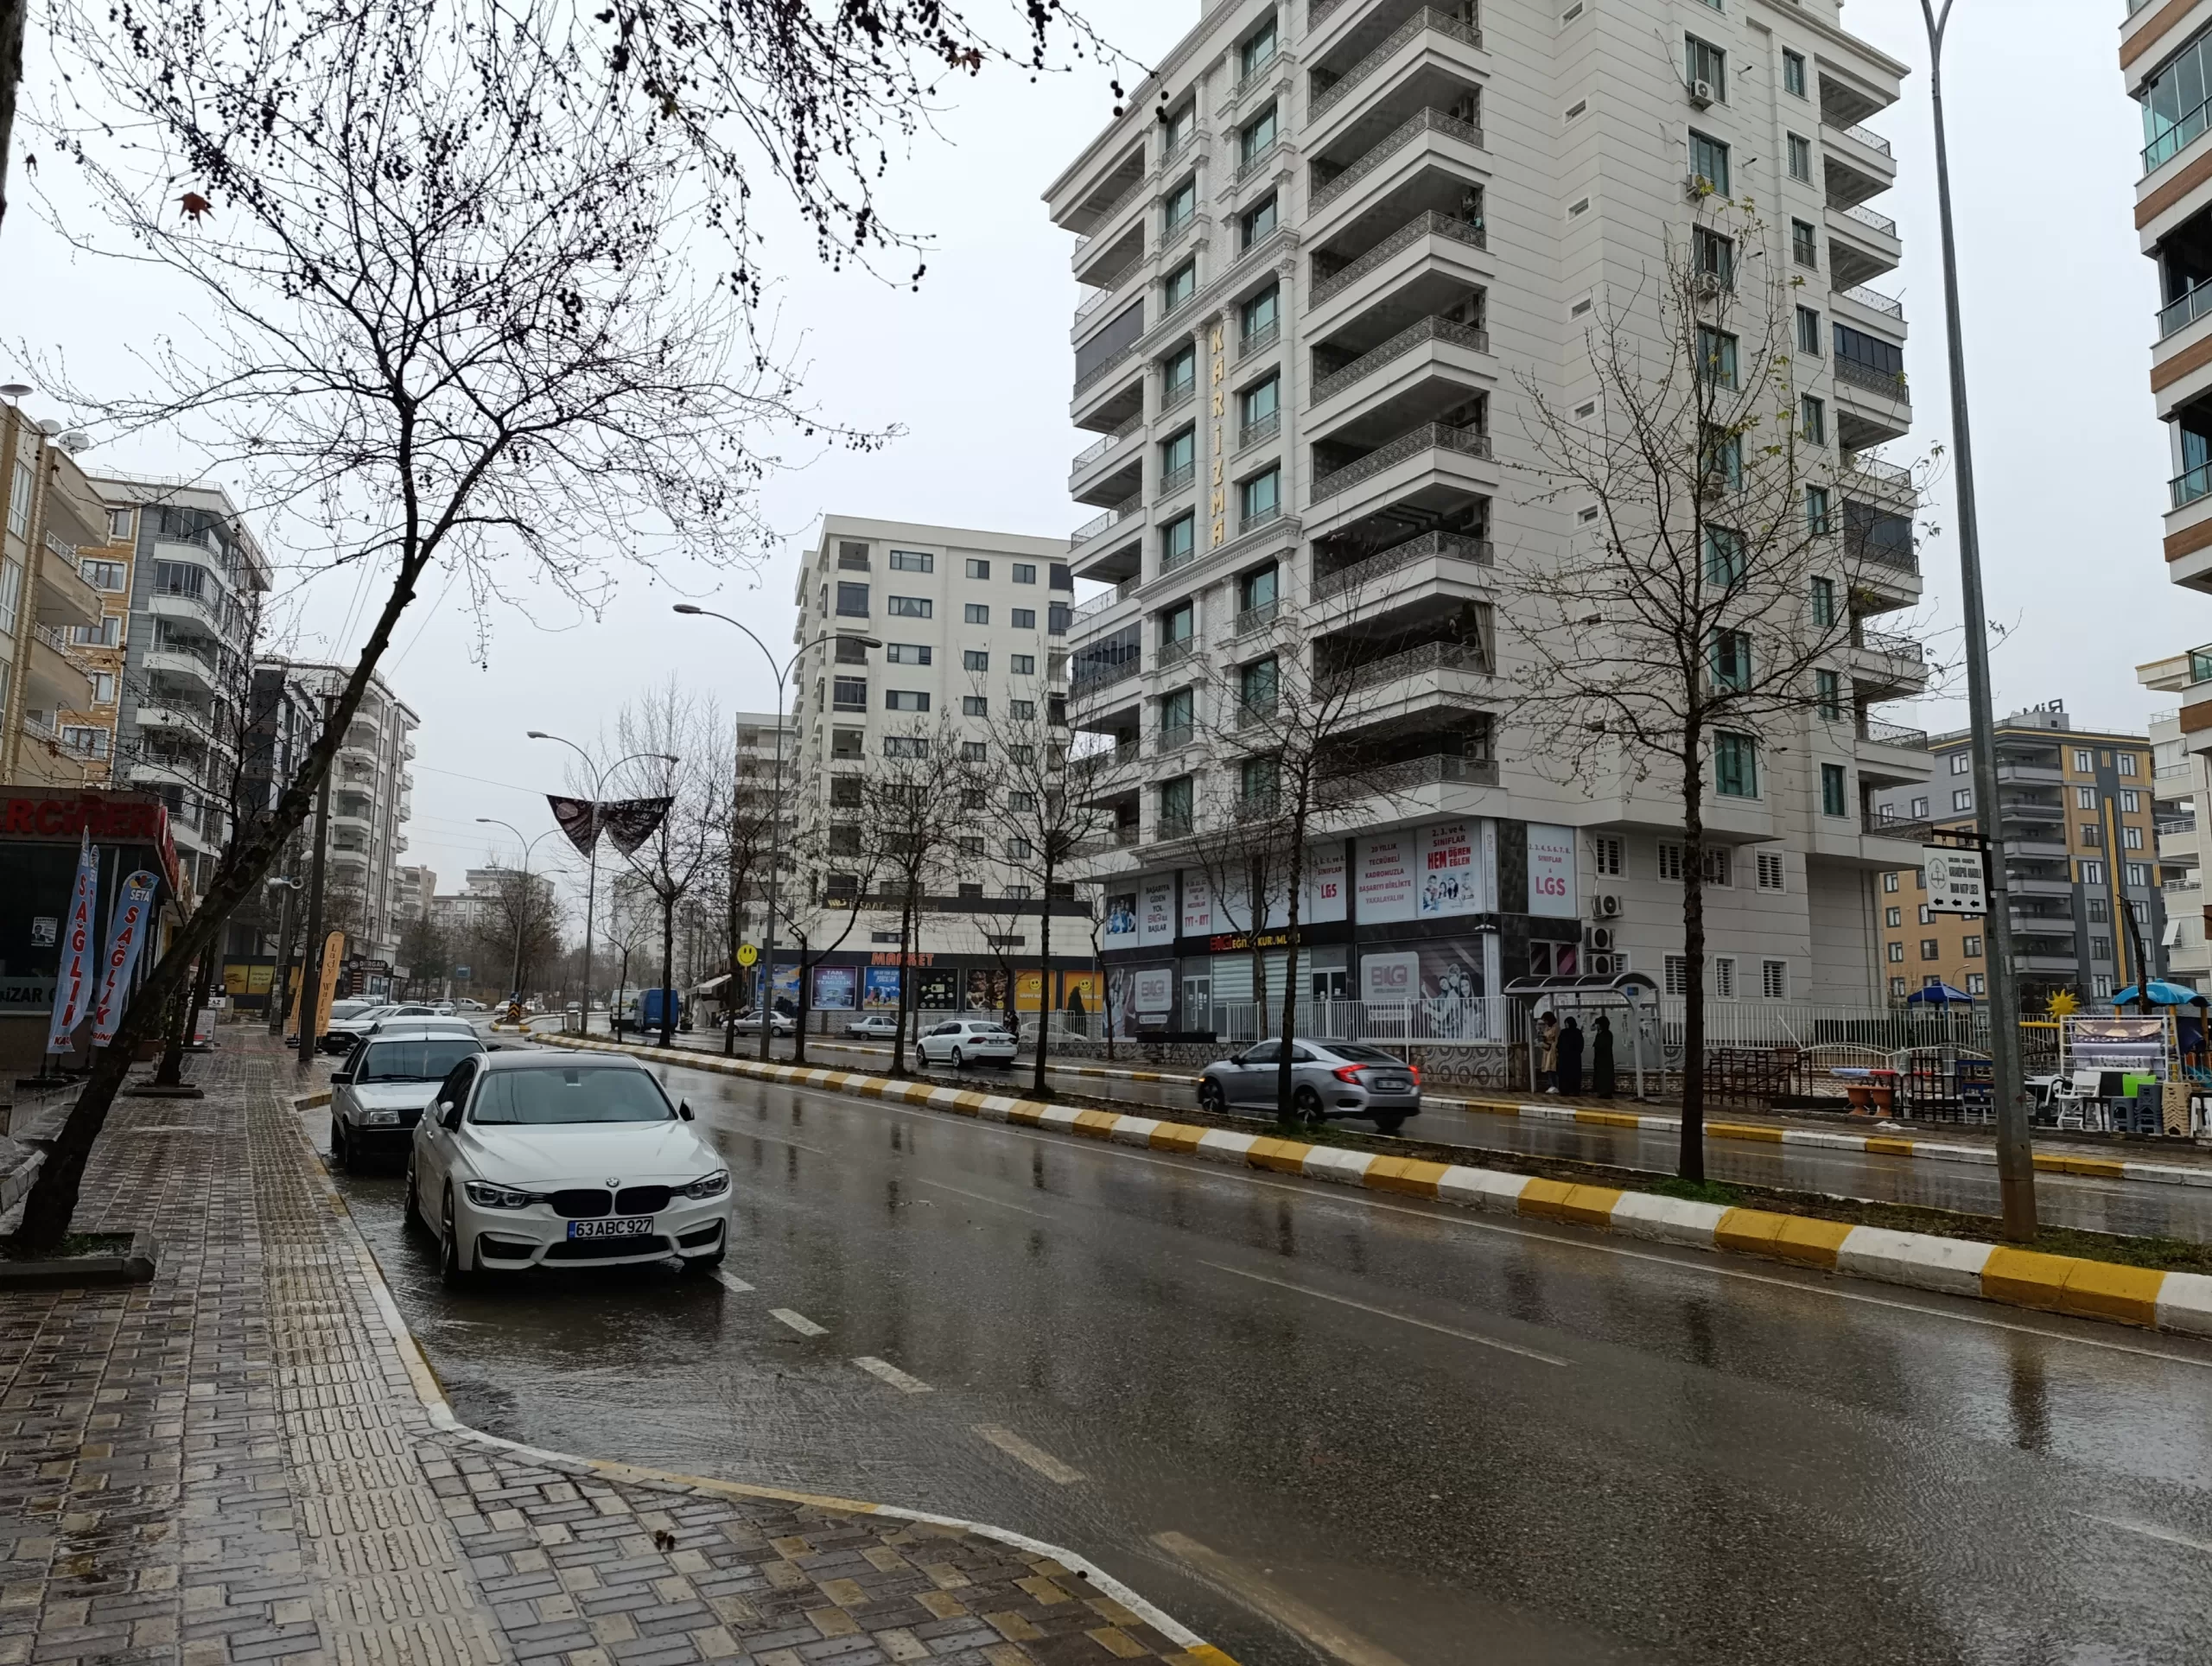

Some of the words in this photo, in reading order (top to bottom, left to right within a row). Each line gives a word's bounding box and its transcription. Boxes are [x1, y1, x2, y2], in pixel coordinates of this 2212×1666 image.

[1433, 835, 1466, 848] SINIFLAR
[1427, 850, 1446, 870] HEM
[1538, 855, 1562, 863] SINIFLAR
[1320, 883, 1338, 900] LGS
[1535, 876, 1566, 896] LGS
[130, 889, 150, 902] SETA
[326, 943, 337, 977] Lady
